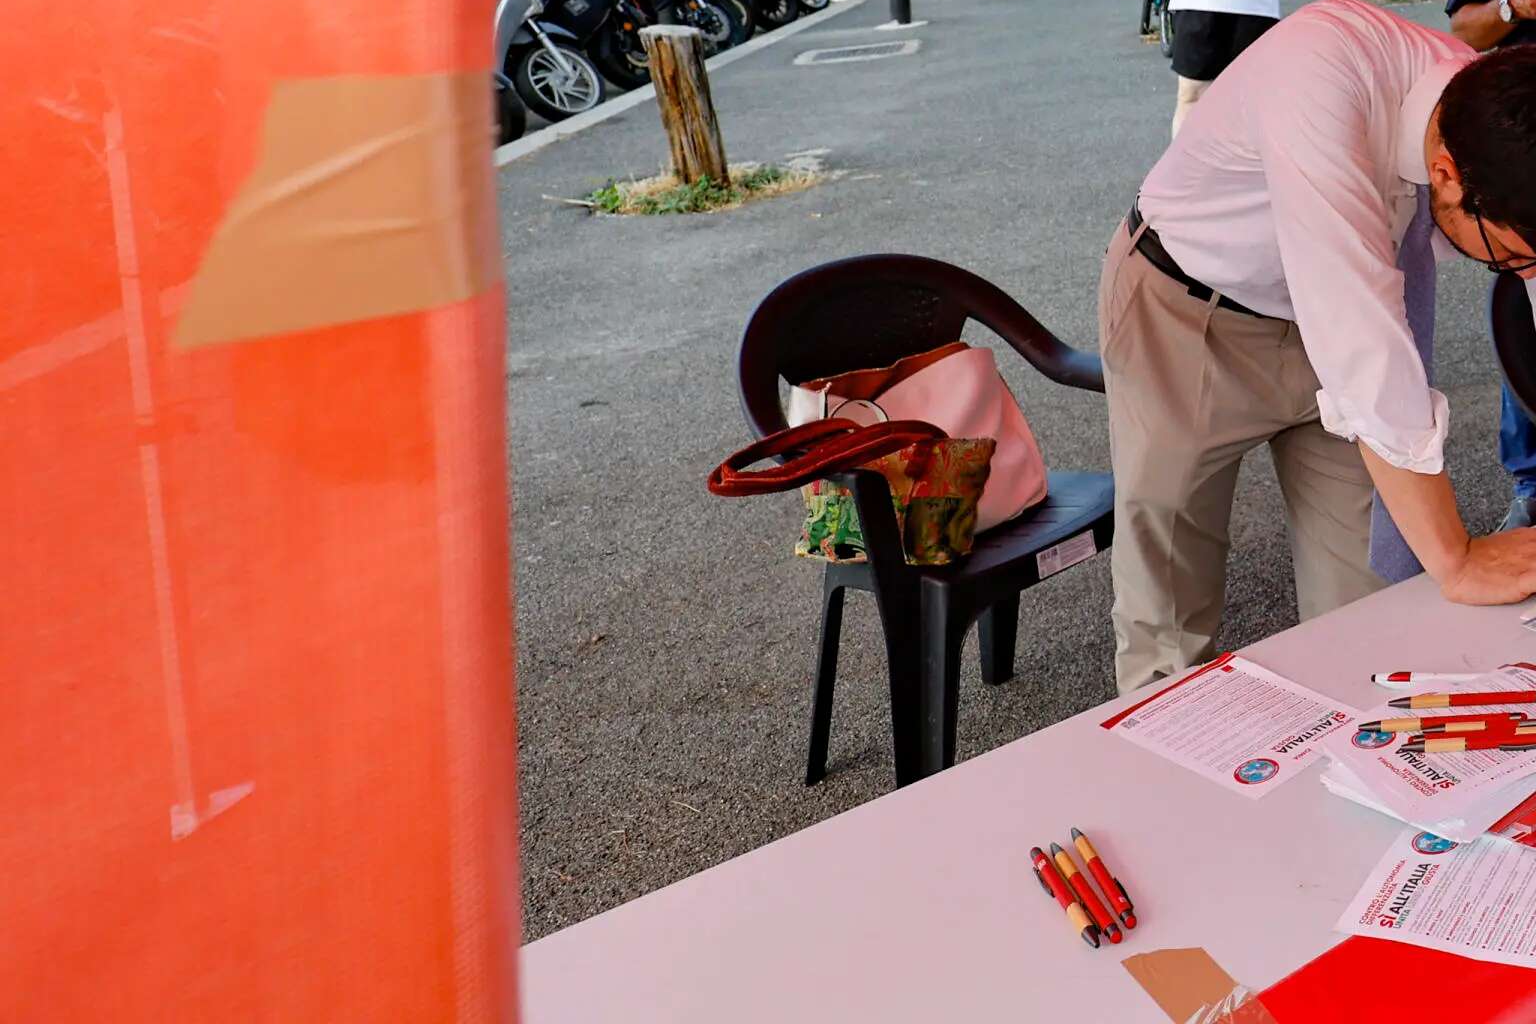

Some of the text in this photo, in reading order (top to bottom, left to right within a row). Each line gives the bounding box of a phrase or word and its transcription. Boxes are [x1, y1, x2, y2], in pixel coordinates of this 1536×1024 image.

[1279, 720, 1332, 753] ALL'ITALIA
[1377, 913, 1397, 929] SÌ
[1389, 863, 1430, 914] ALL'ITALIA
